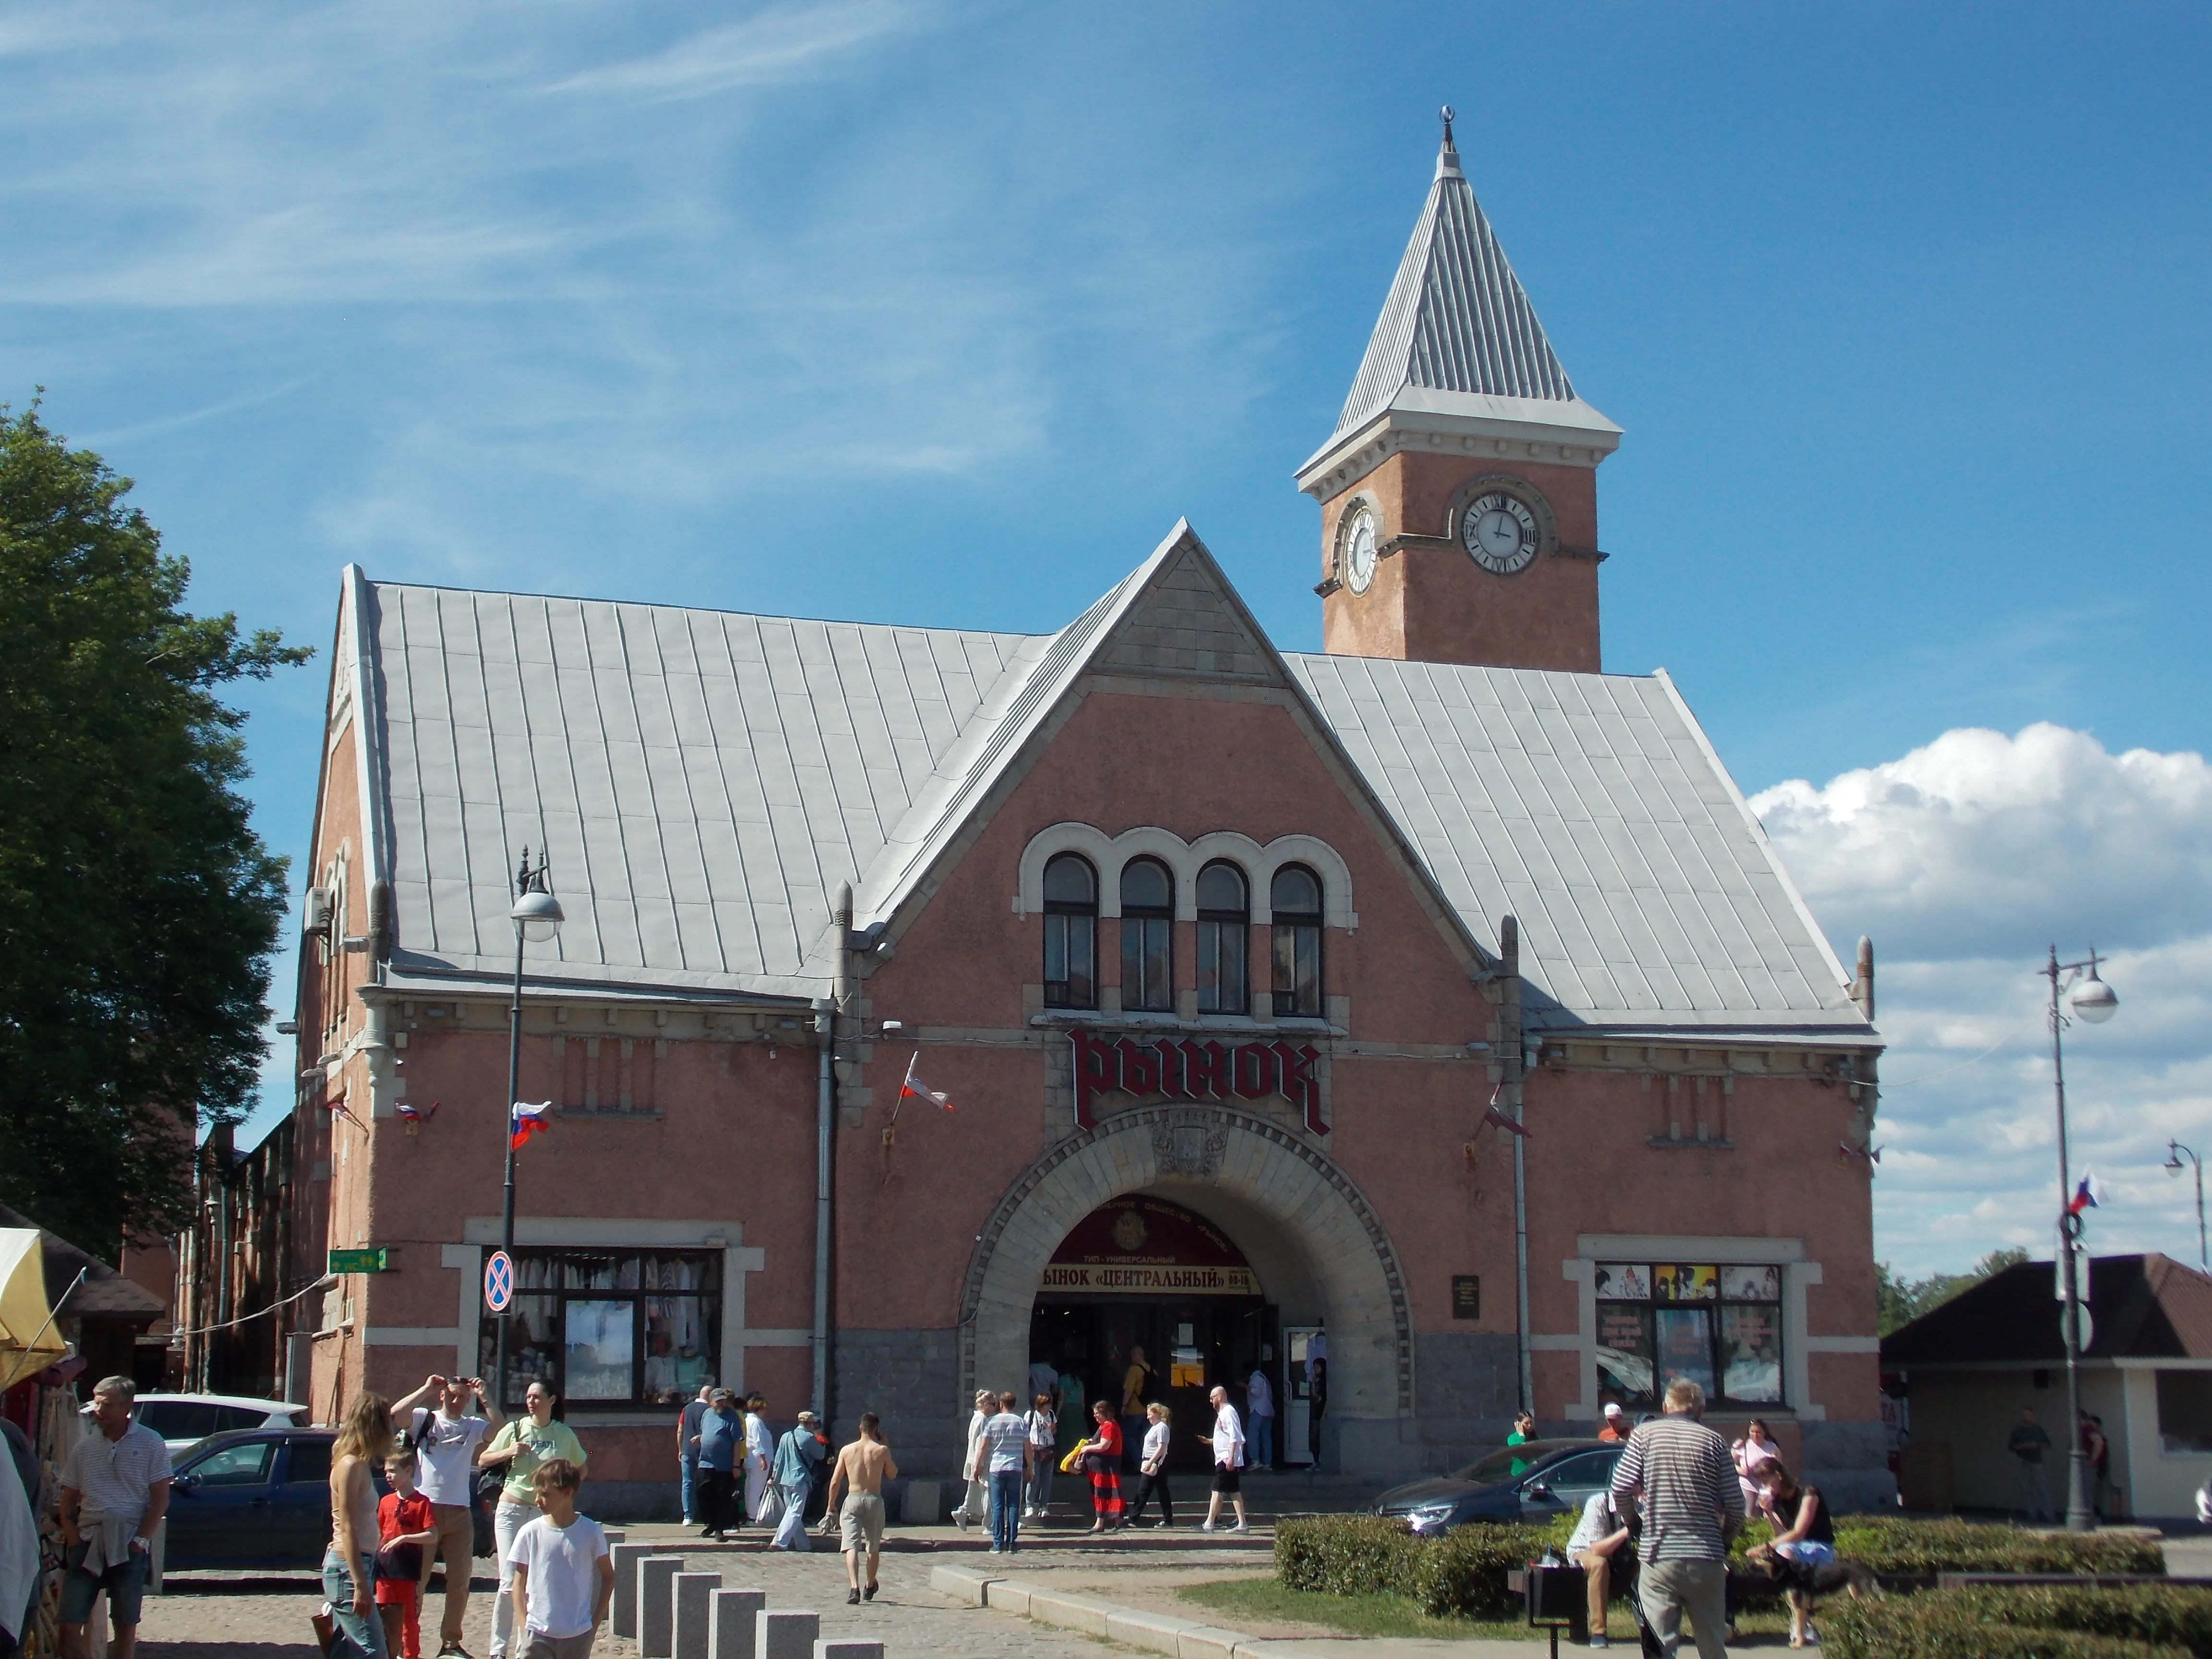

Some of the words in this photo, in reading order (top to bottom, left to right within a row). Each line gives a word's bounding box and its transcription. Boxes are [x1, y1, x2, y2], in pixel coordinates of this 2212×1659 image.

[1466, 524, 1476, 537] IX
[1525, 529, 1535, 543] III
[1105, 1255, 1176, 1263] УНИВЕРСАЛЬНЫЙ
[1095, 1268, 1225, 1288] «ЦЕНТРАЛЬНЫЙ»
